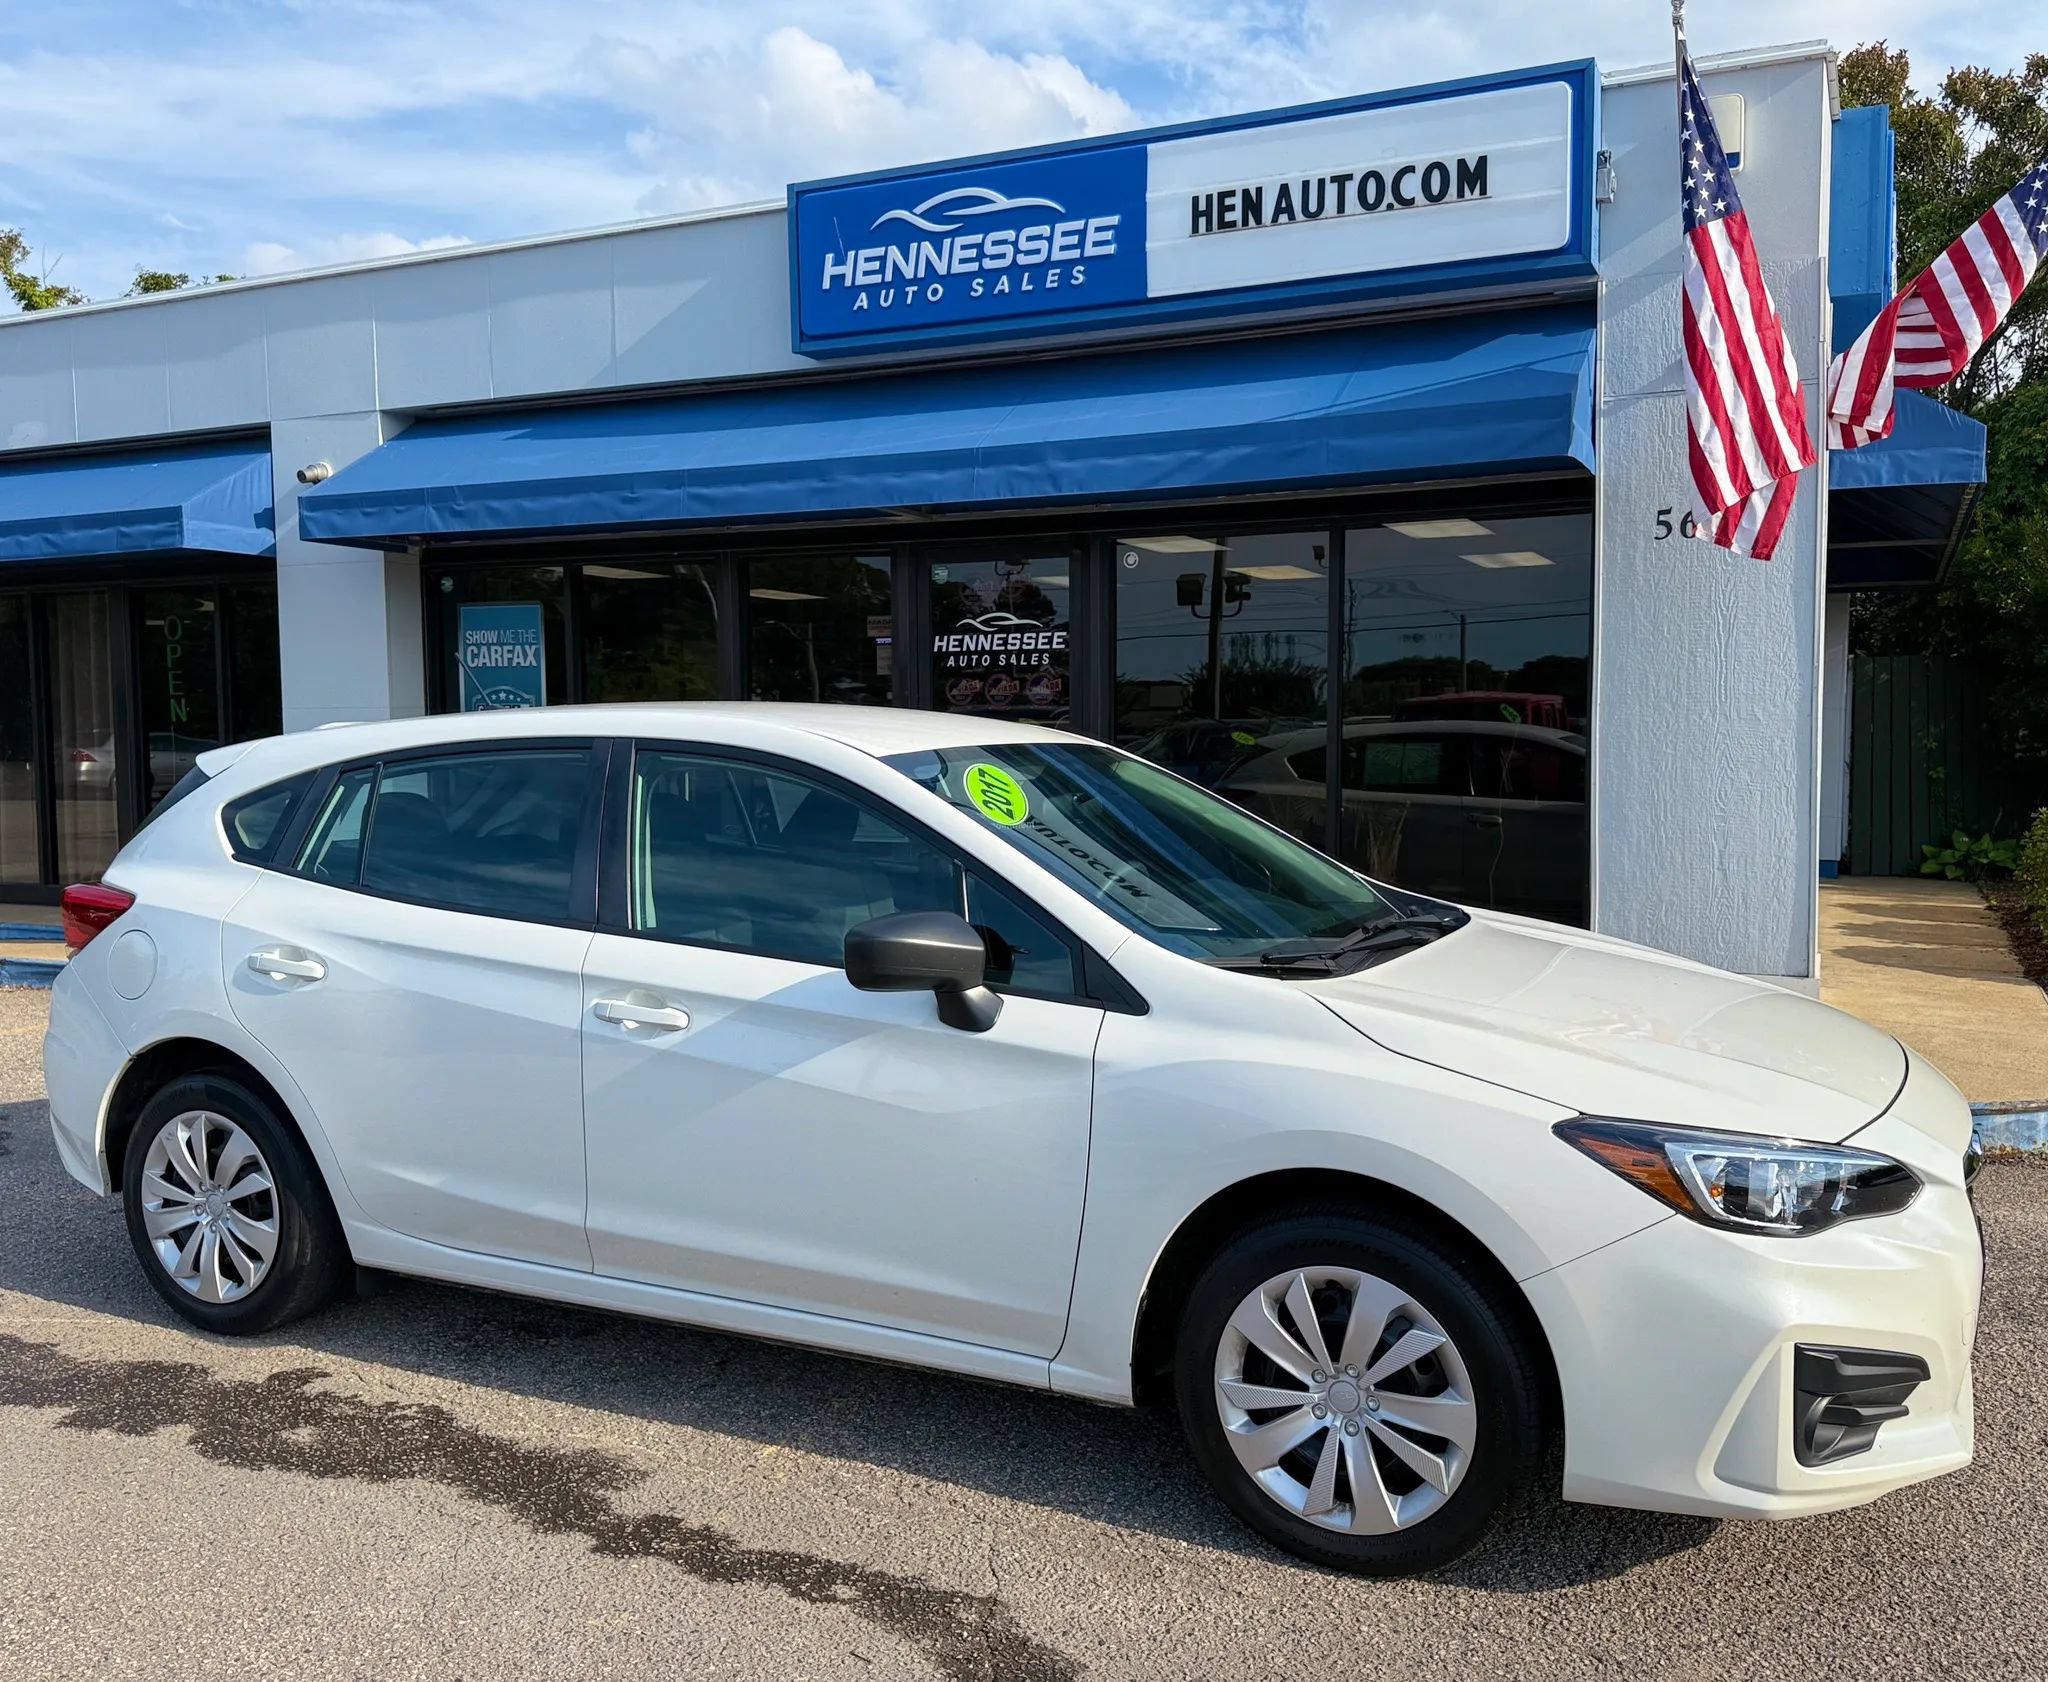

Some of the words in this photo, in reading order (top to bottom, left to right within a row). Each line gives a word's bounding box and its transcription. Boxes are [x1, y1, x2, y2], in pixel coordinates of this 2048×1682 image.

[1191, 155, 1488, 235] HENAUTO.COM
[821, 215, 1120, 290] HENNESSEE
[853, 283, 944, 311] AUTO
[970, 265, 1085, 298] SALES
[465, 630, 498, 645] SHOW
[500, 629, 516, 643] ME
[518, 628, 537, 643] THE
[466, 644, 539, 668] CARFAX
[933, 631, 1068, 652] HENNESSEE
[947, 654, 991, 667] AUTO
[999, 652, 1050, 666] SALES
[163, 615, 188, 723] OPEN
[977, 767, 1015, 820] 2017
